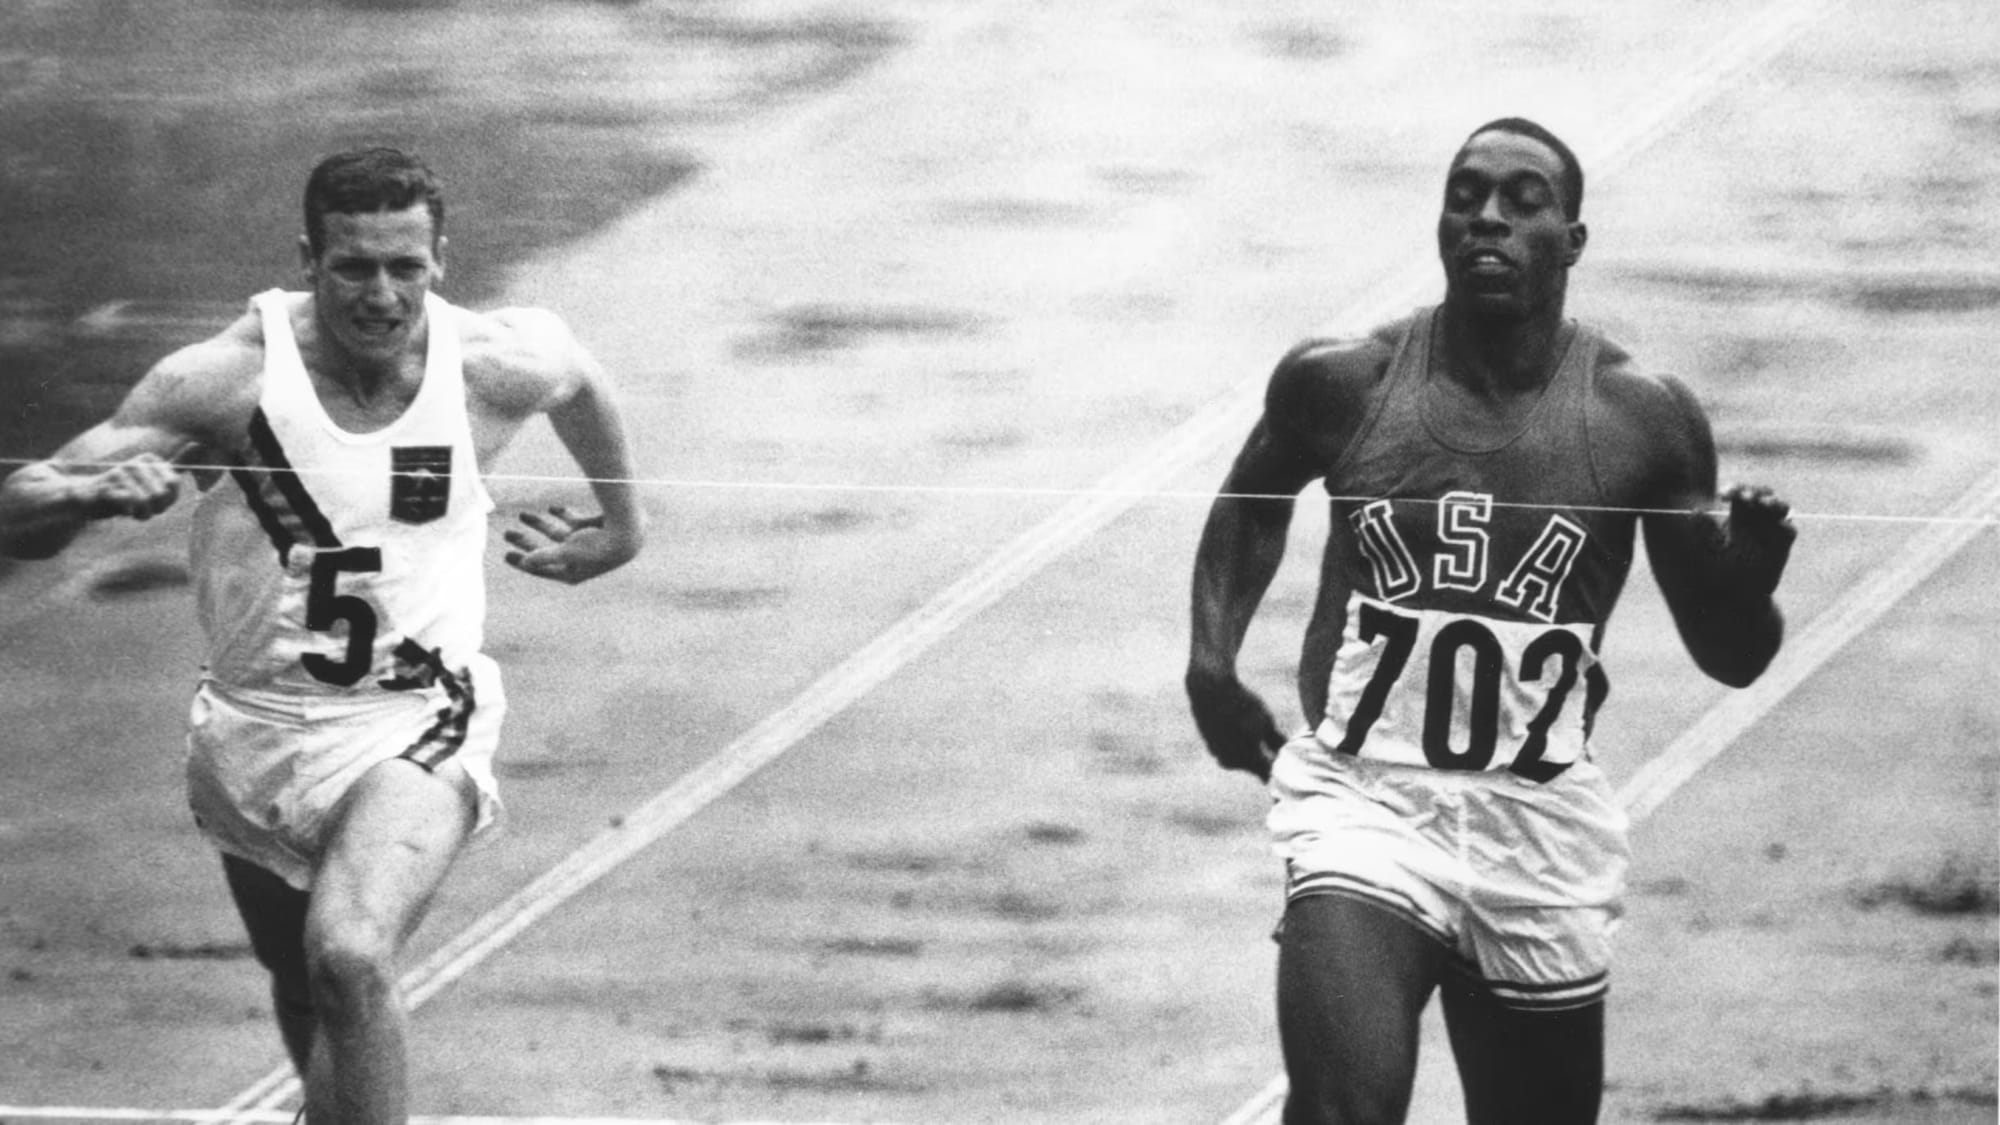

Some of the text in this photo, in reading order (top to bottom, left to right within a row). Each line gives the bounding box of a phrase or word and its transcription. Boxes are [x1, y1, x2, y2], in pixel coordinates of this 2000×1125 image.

[301, 547, 382, 686] 5
[1349, 491, 1586, 624] USA
[1336, 602, 1583, 783] 702
